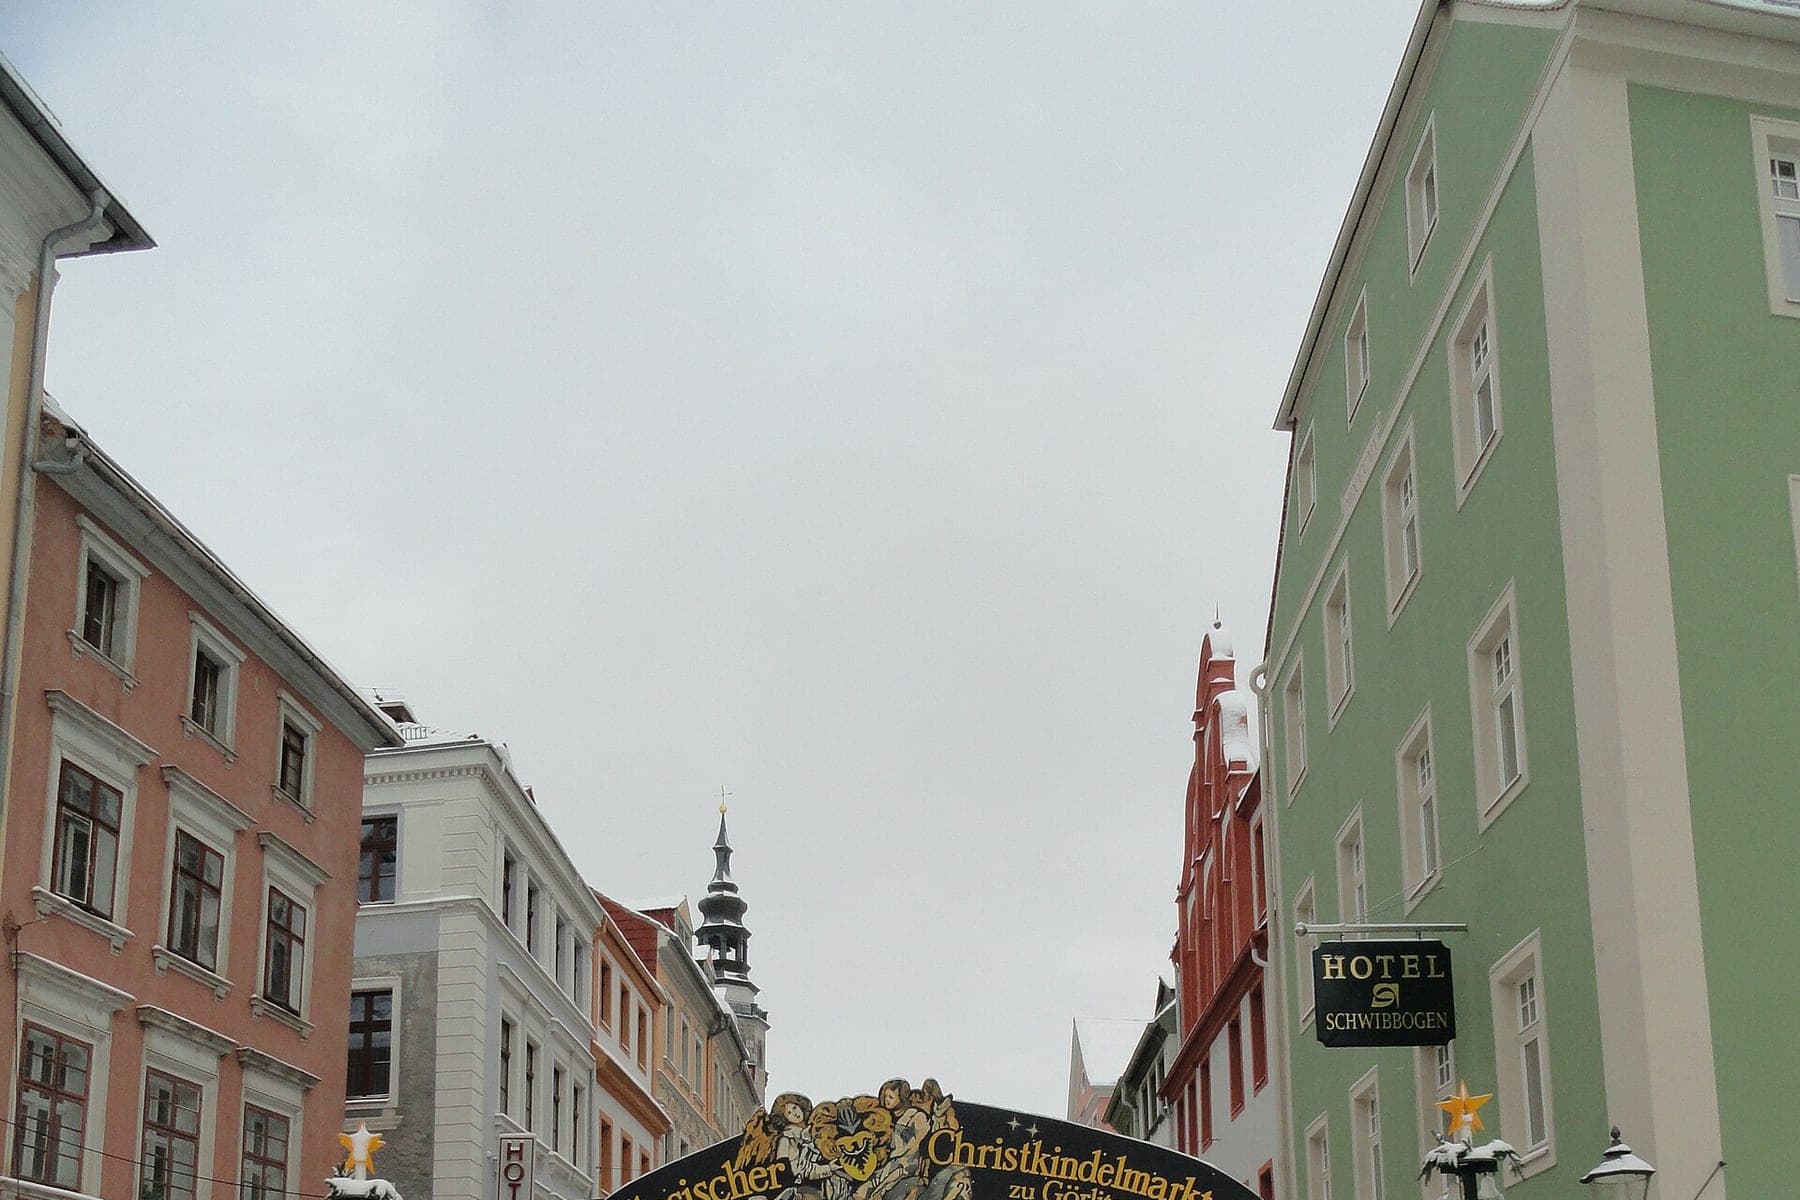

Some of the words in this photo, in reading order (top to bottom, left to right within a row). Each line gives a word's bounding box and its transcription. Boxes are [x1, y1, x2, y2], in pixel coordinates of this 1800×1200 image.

[1321, 954, 1446, 980] HOTEL
[1326, 1011, 1448, 1031] SCHWIBBOGEN
[1008, 1183, 1036, 1200] zu
